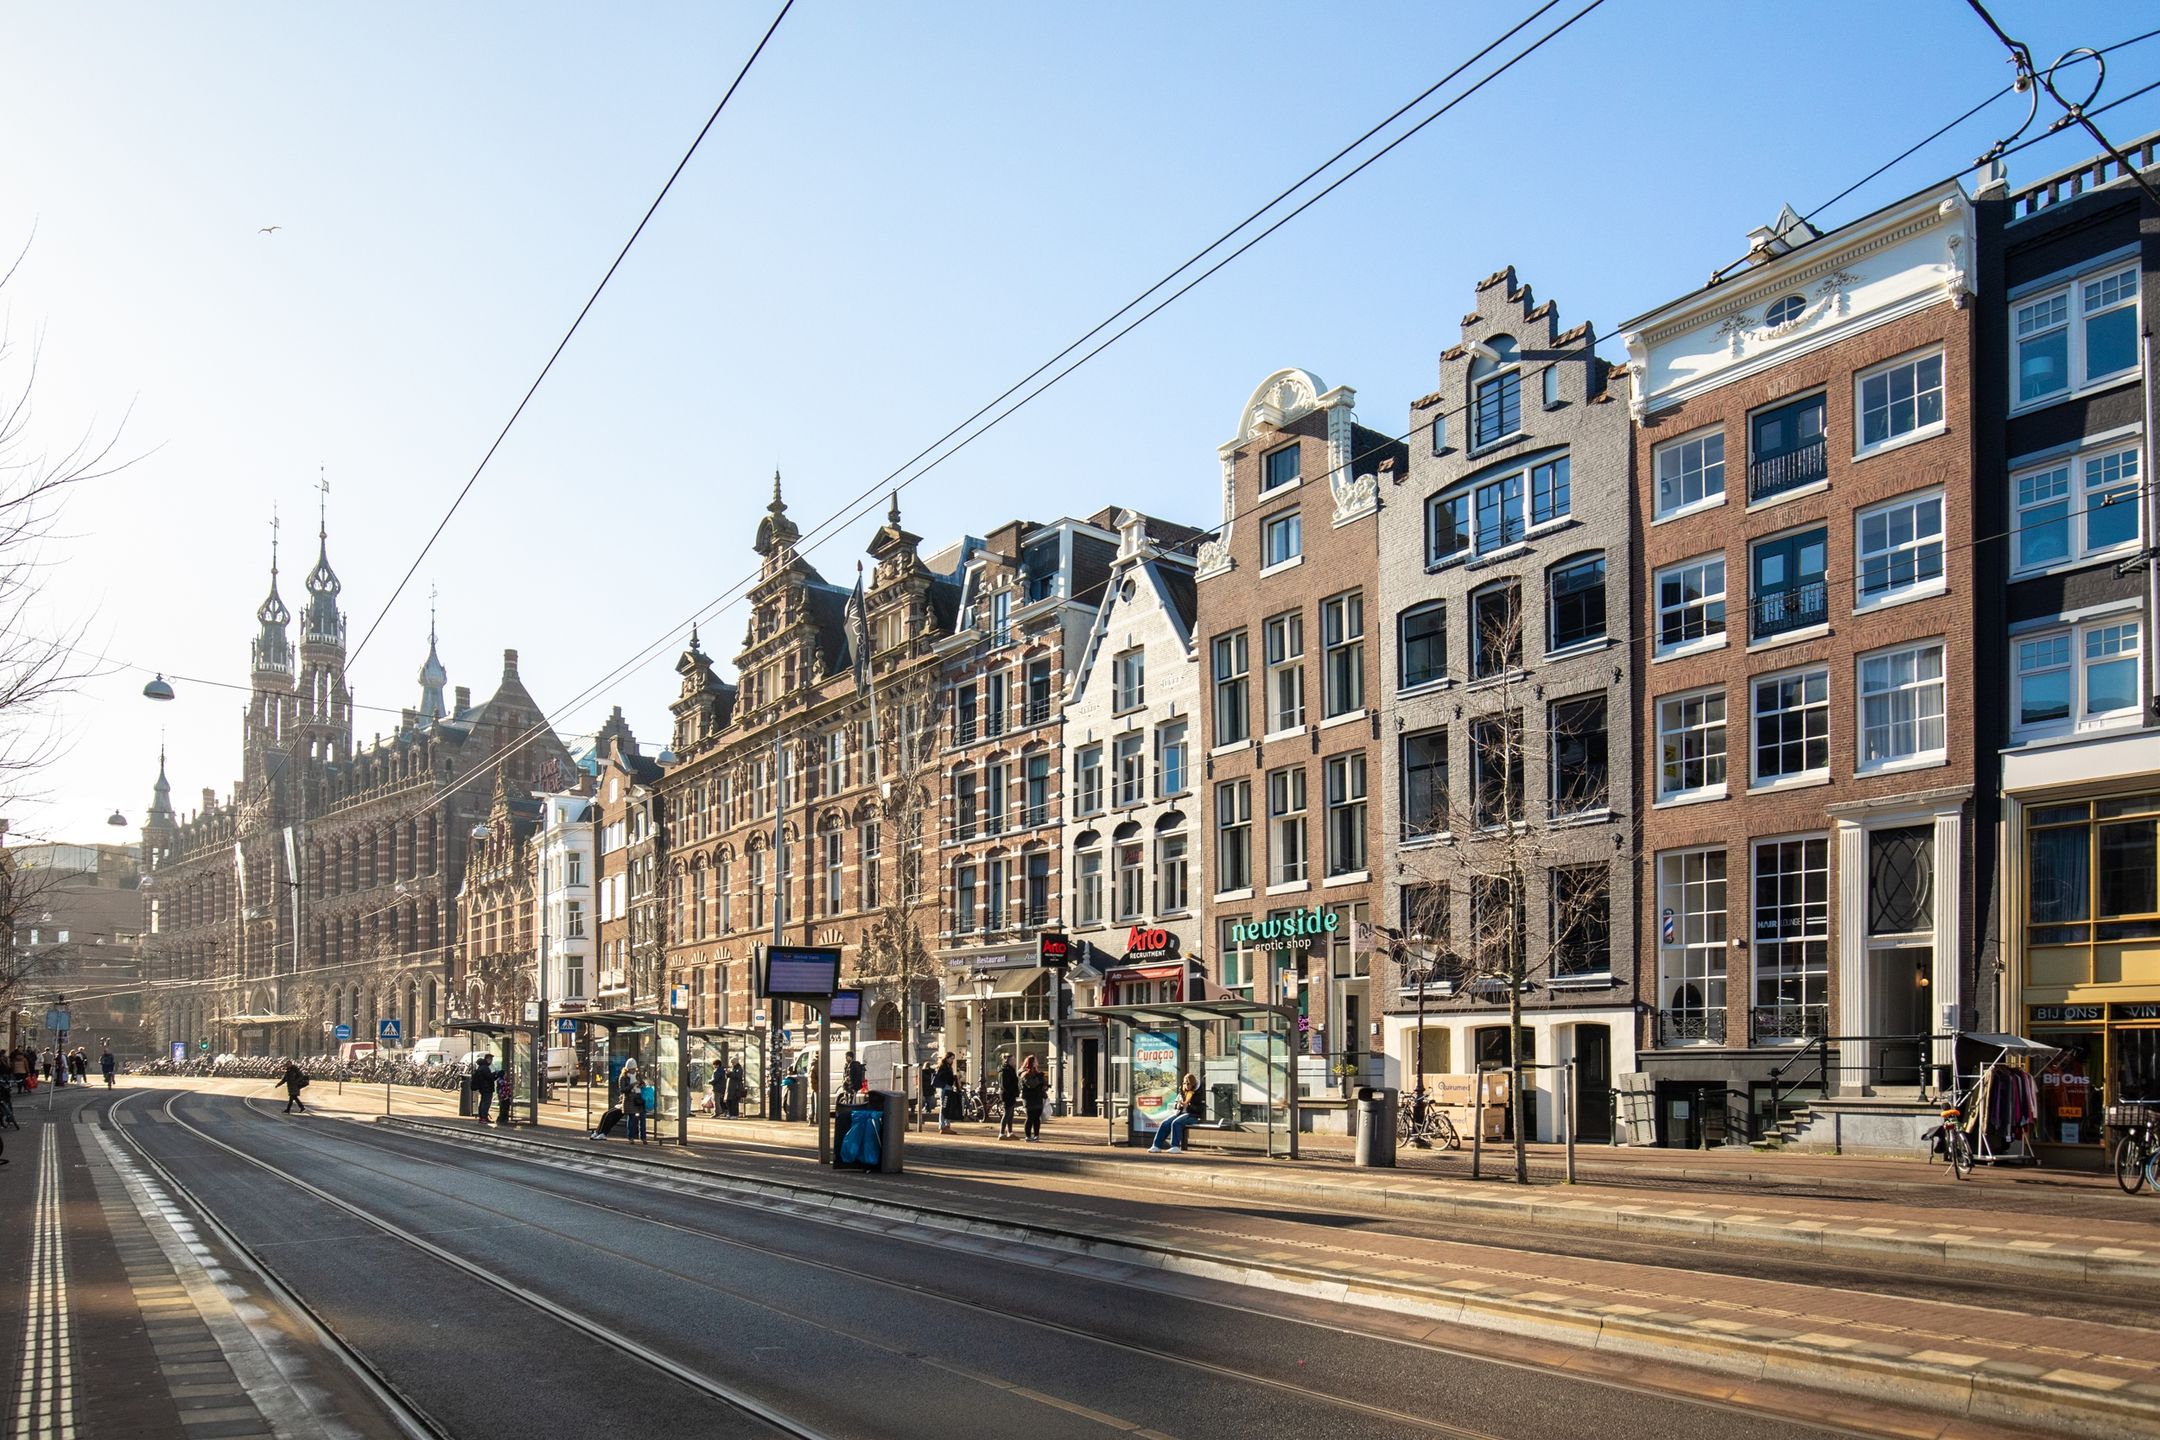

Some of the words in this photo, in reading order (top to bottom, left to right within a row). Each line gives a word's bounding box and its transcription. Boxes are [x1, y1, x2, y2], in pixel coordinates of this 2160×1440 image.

[1232, 905, 1339, 943] newside
[1757, 920, 1778, 929] HAIR
[1127, 925, 1167, 952] Arto
[1255, 939, 1284, 951] erotic
[1287, 936, 1312, 950] shop
[1042, 940, 1067, 953] Arto
[976, 954, 1007, 965] Restaurant
[1129, 949, 1166, 960] RECRUITMENT
[2037, 1008, 2059, 1019] BIJ
[2064, 1007, 2098, 1018] ONS
[2129, 1005, 2160, 1017] VIN
[1136, 1048, 1174, 1064] Curaçao
[2043, 1073, 2060, 1086] Bij
[2061, 1073, 2090, 1084] Ons
